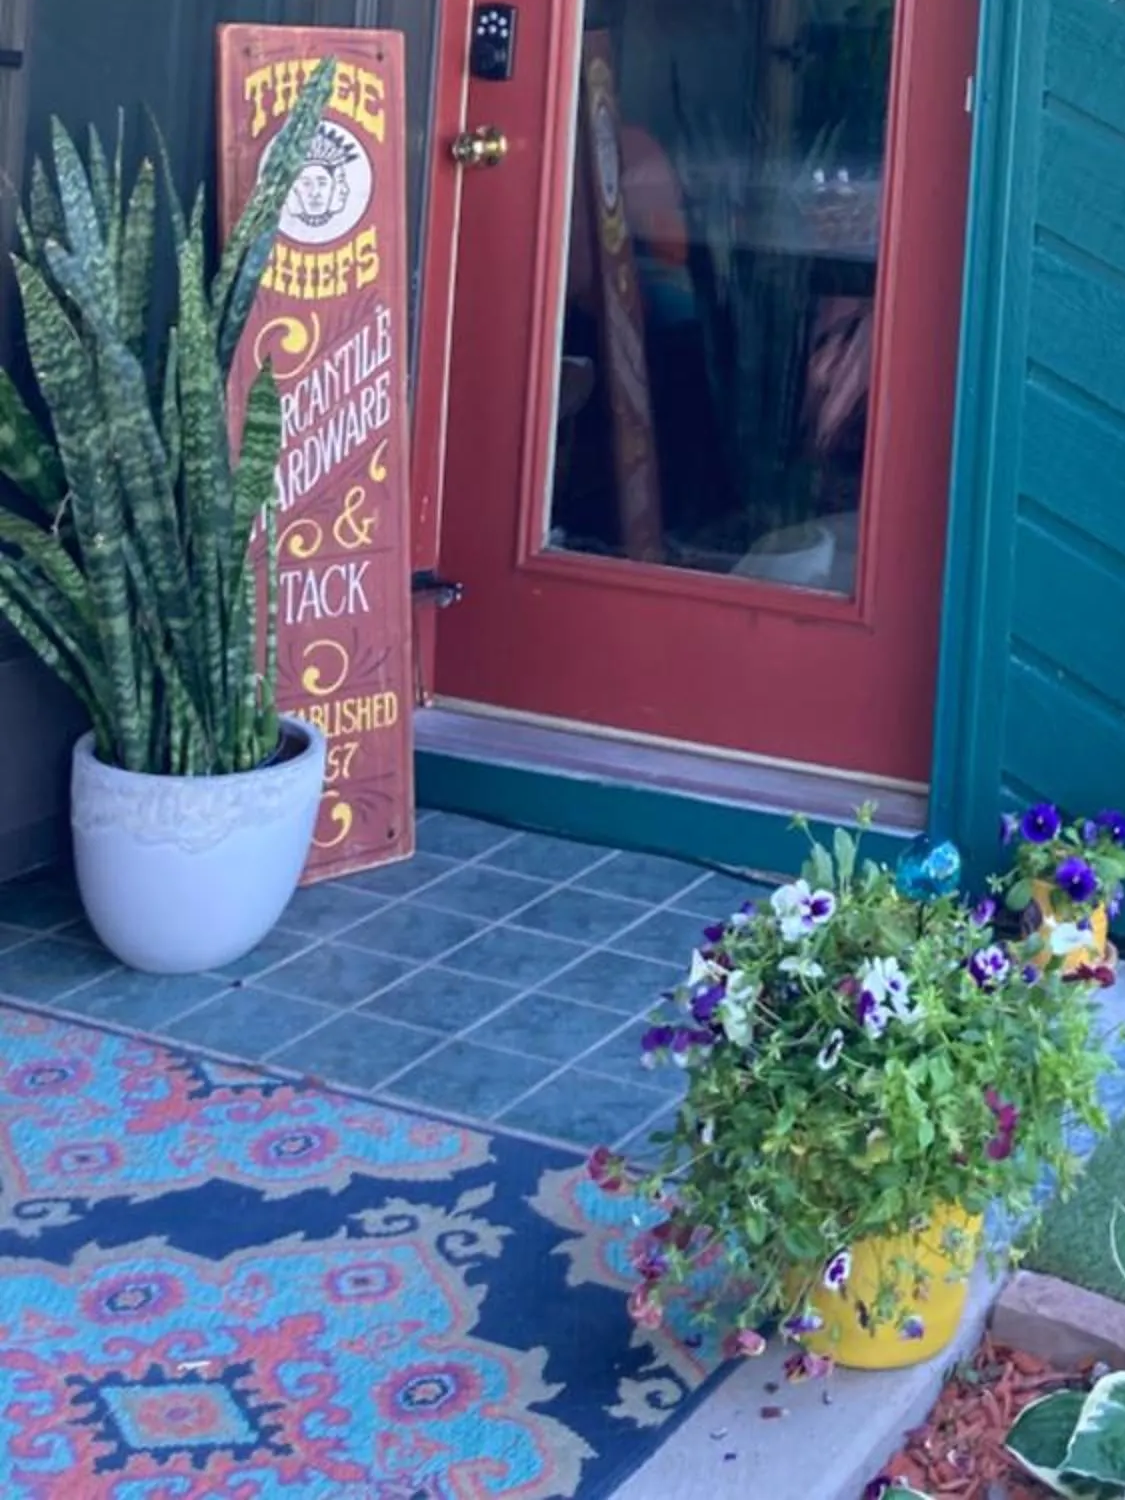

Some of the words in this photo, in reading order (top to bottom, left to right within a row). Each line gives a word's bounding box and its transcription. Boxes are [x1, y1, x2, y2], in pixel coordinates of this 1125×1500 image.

[245, 58, 385, 142] THEE
[279, 306, 391, 449] RCANTILE
[333, 486, 377, 549] &
[279, 560, 371, 625] TACK
[283, 691, 398, 738] BLISHED
[324, 741, 359, 781] 57
